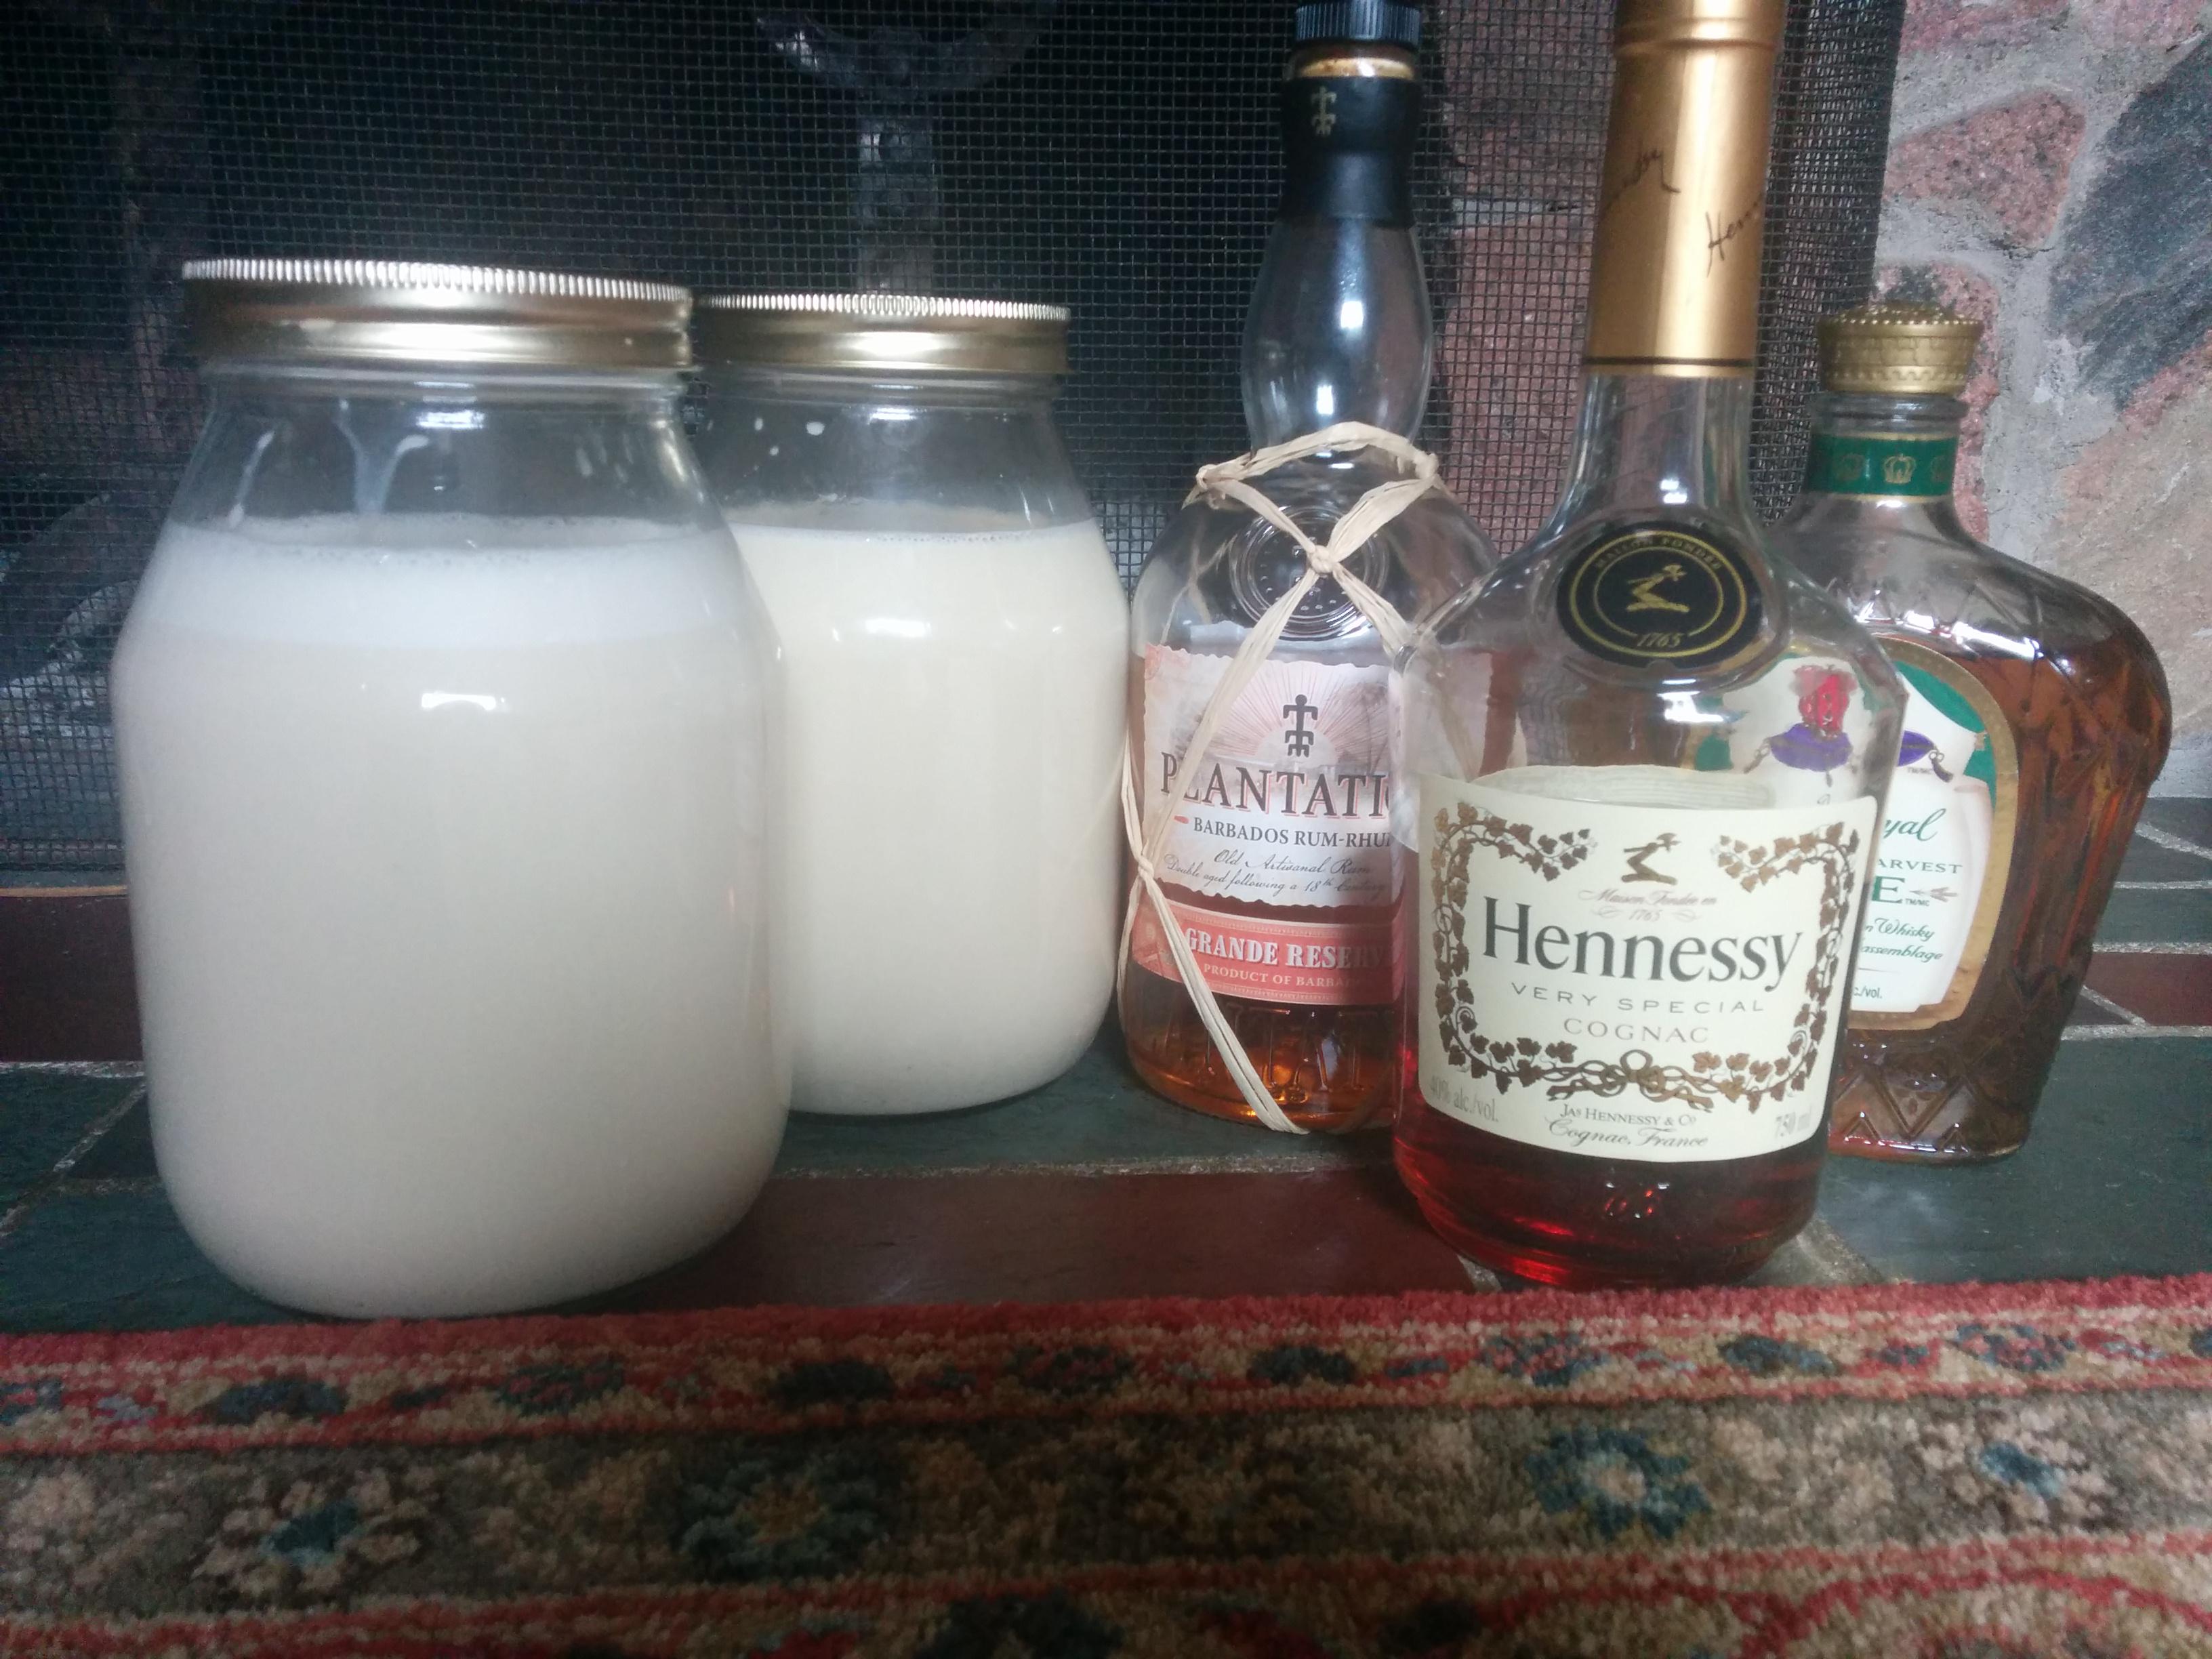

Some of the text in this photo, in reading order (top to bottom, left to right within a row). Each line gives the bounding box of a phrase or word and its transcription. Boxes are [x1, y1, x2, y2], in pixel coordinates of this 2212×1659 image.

[1193, 817, 1391, 848] BARBADOS RUM-RHU
[1214, 848, 1245, 865] Old
[1245, 853, 1332, 874] Artisanal
[1203, 870, 1231, 888] aged
[1224, 868, 1286, 897] following
[1483, 895, 1803, 992] Hennessy
[1875, 917, 1936, 943] Whisky
[1184, 926, 1279, 967] GRANDE
[1204, 962, 1269, 984] PRODUCT
[1272, 975, 1292, 986] OF
[1511, 981, 1765, 1014] VERY SPECIAL
[1563, 1017, 1709, 1044] COGNAC
[1584, 1107, 1662, 1126] HENNESSY
[1664, 1118, 1674, 1126] &
[1636, 1126, 1709, 1147] France
